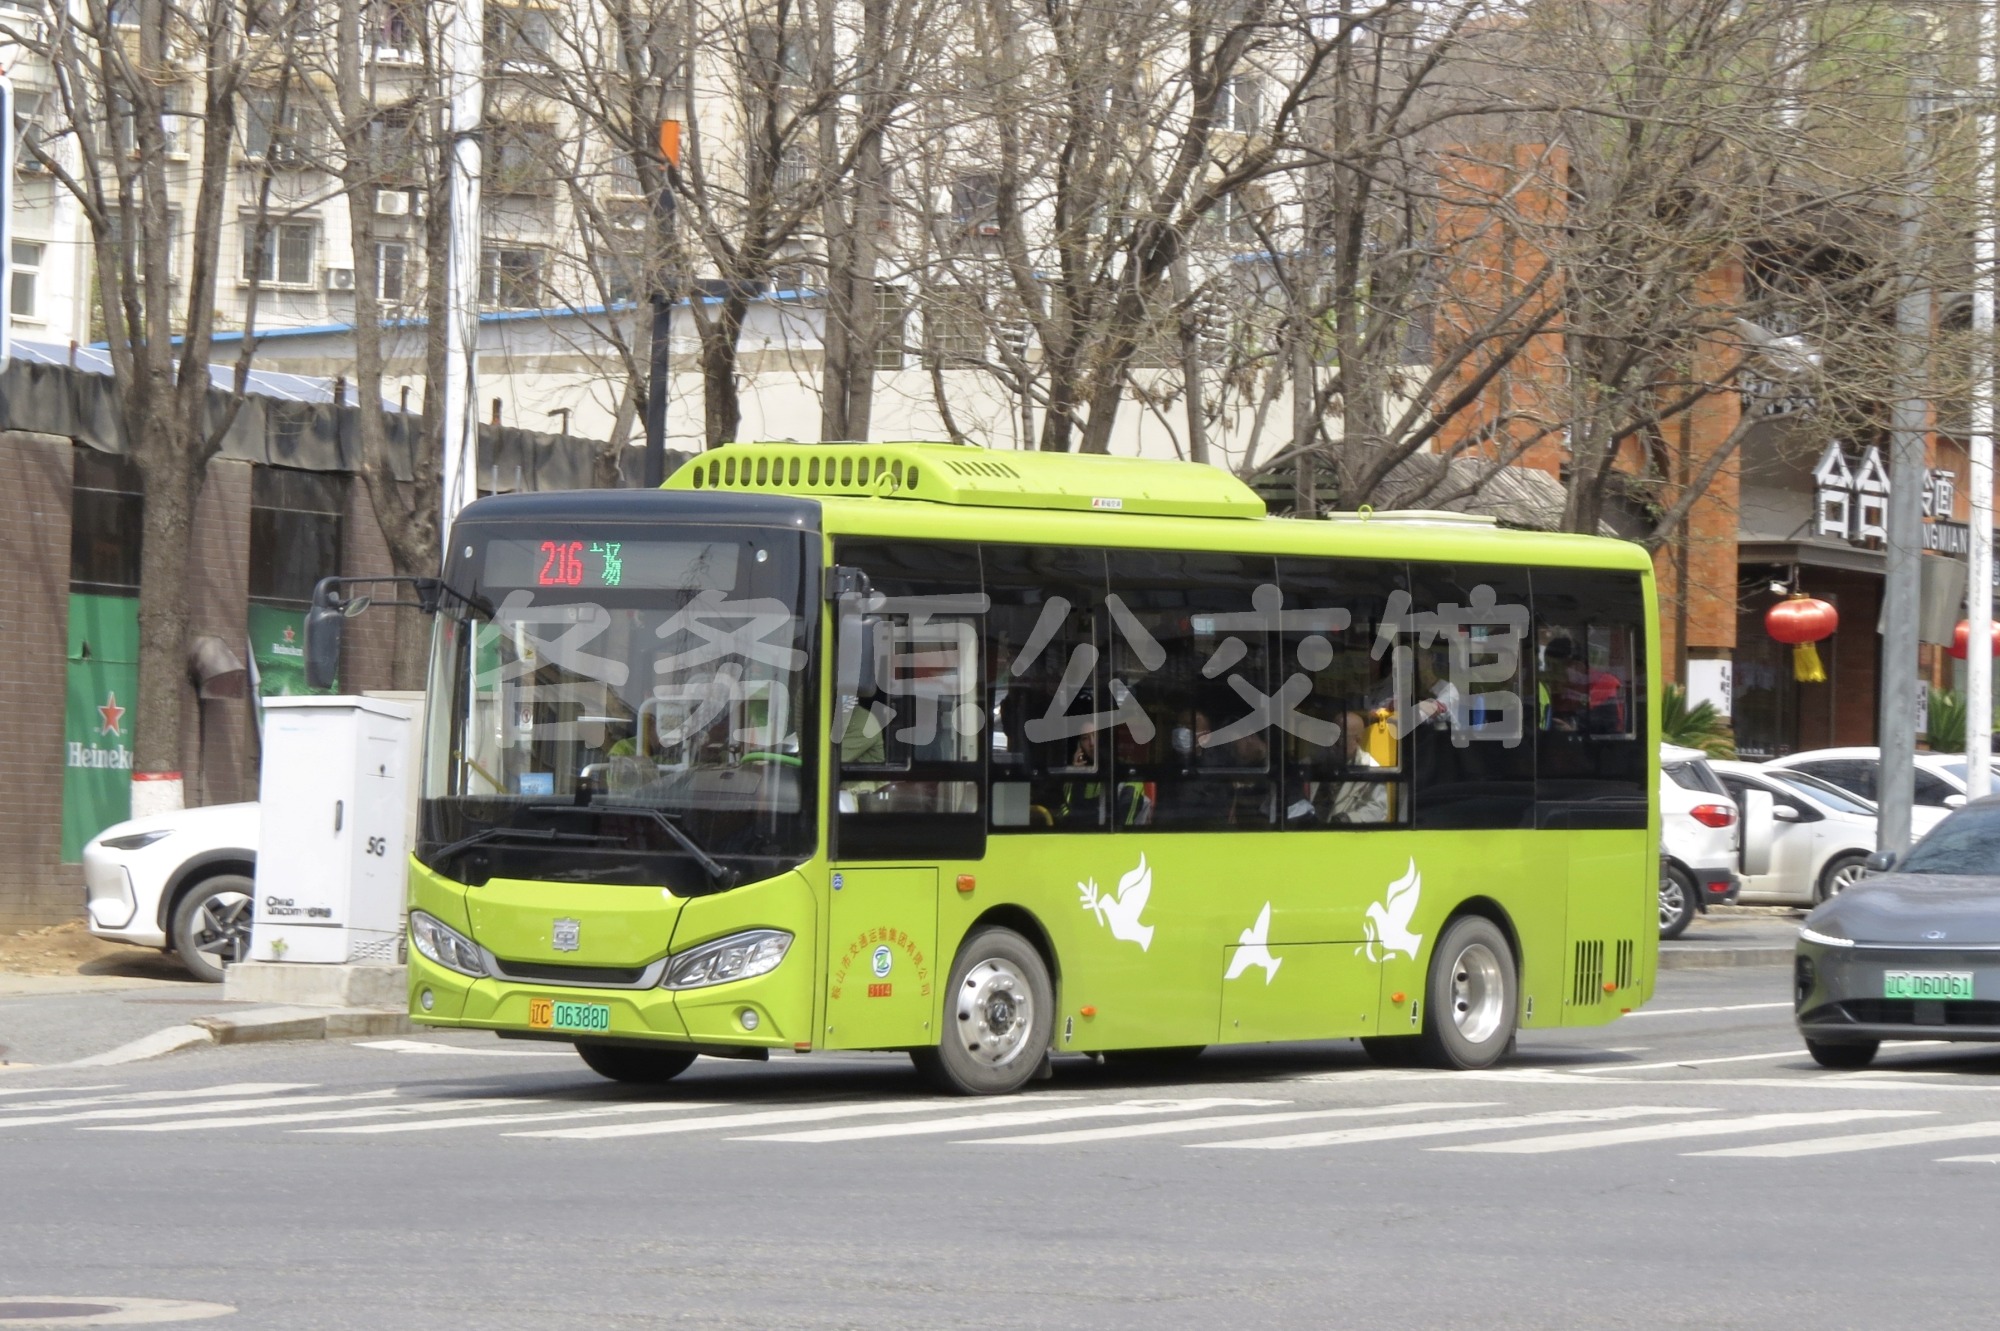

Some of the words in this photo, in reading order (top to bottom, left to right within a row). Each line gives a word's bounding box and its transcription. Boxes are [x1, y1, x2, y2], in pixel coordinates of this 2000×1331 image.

[1922, 523, 1968, 554] NGMIAN
[539, 541, 584, 585] 216
[366, 836, 386, 857] 5G
[831, 926, 931, 1000] 鞍山市交通运输集团有限公司
[869, 984, 892, 997] 3114
[1913, 976, 1970, 995] D60061
[531, 1003, 550, 1025] 辽C
[556, 1005, 608, 1030] 06388D
